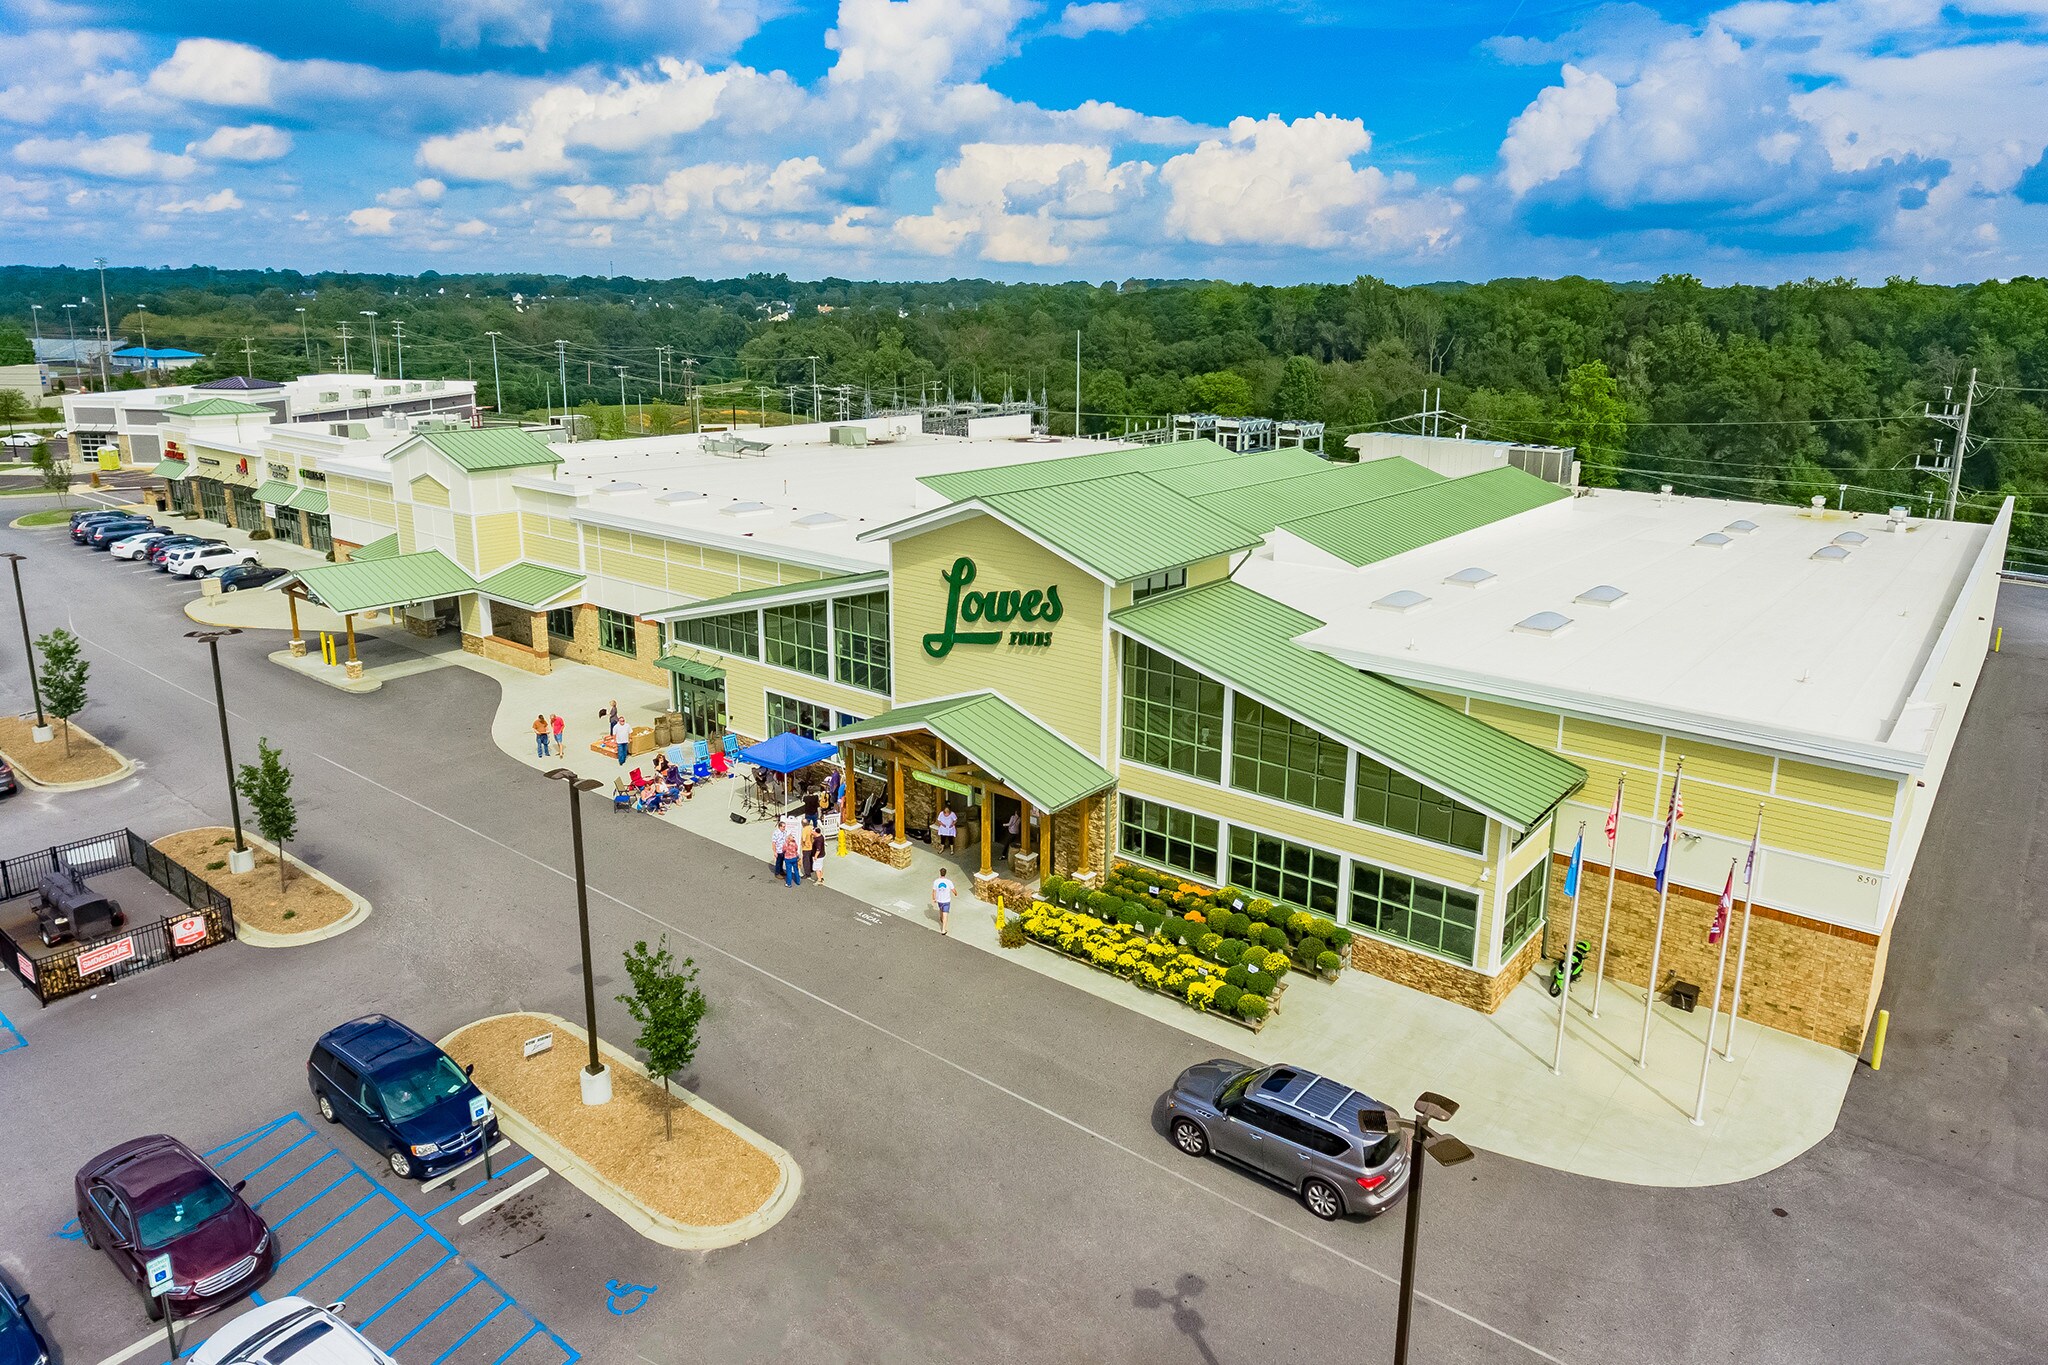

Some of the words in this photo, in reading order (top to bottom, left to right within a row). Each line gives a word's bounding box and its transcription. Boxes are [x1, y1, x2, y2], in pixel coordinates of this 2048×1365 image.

[923, 557, 1064, 658] Lowes
[1008, 631, 1053, 647] FOODS
[1857, 875, 1877, 886] 850
[83, 944, 128, 968] SMOKEHOUSE
